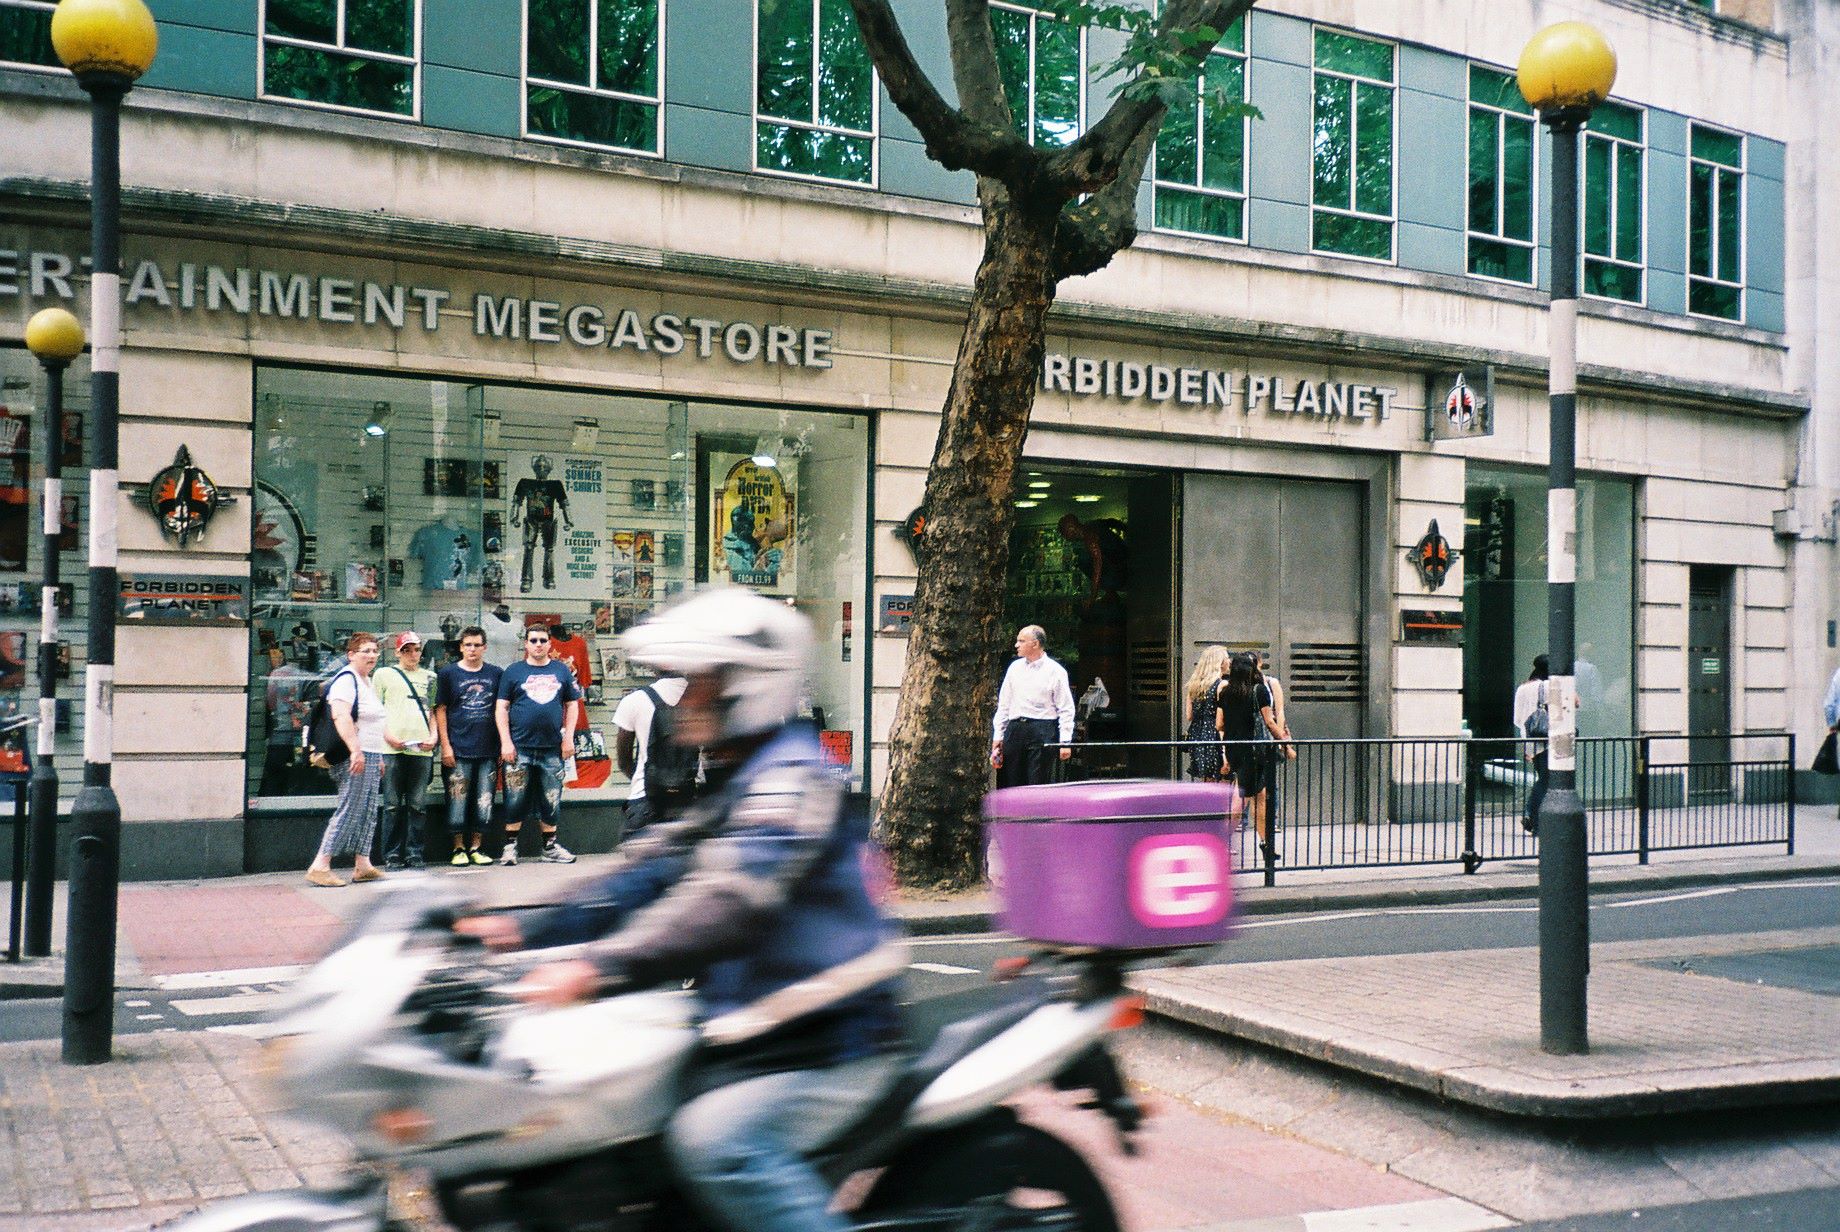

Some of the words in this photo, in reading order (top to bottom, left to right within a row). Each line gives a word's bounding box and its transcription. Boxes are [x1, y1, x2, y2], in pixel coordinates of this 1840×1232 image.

[0, 250, 450, 332] ERAINMENT
[474, 293, 833, 369] MEGASTORE
[1041, 353, 1233, 407] RBIDDEN
[1246, 374, 1398, 421] PLANET
[565, 469, 602, 481] SUMMER
[119, 581, 243, 594] FORBIDDEN
[140, 598, 224, 611] PLANET
